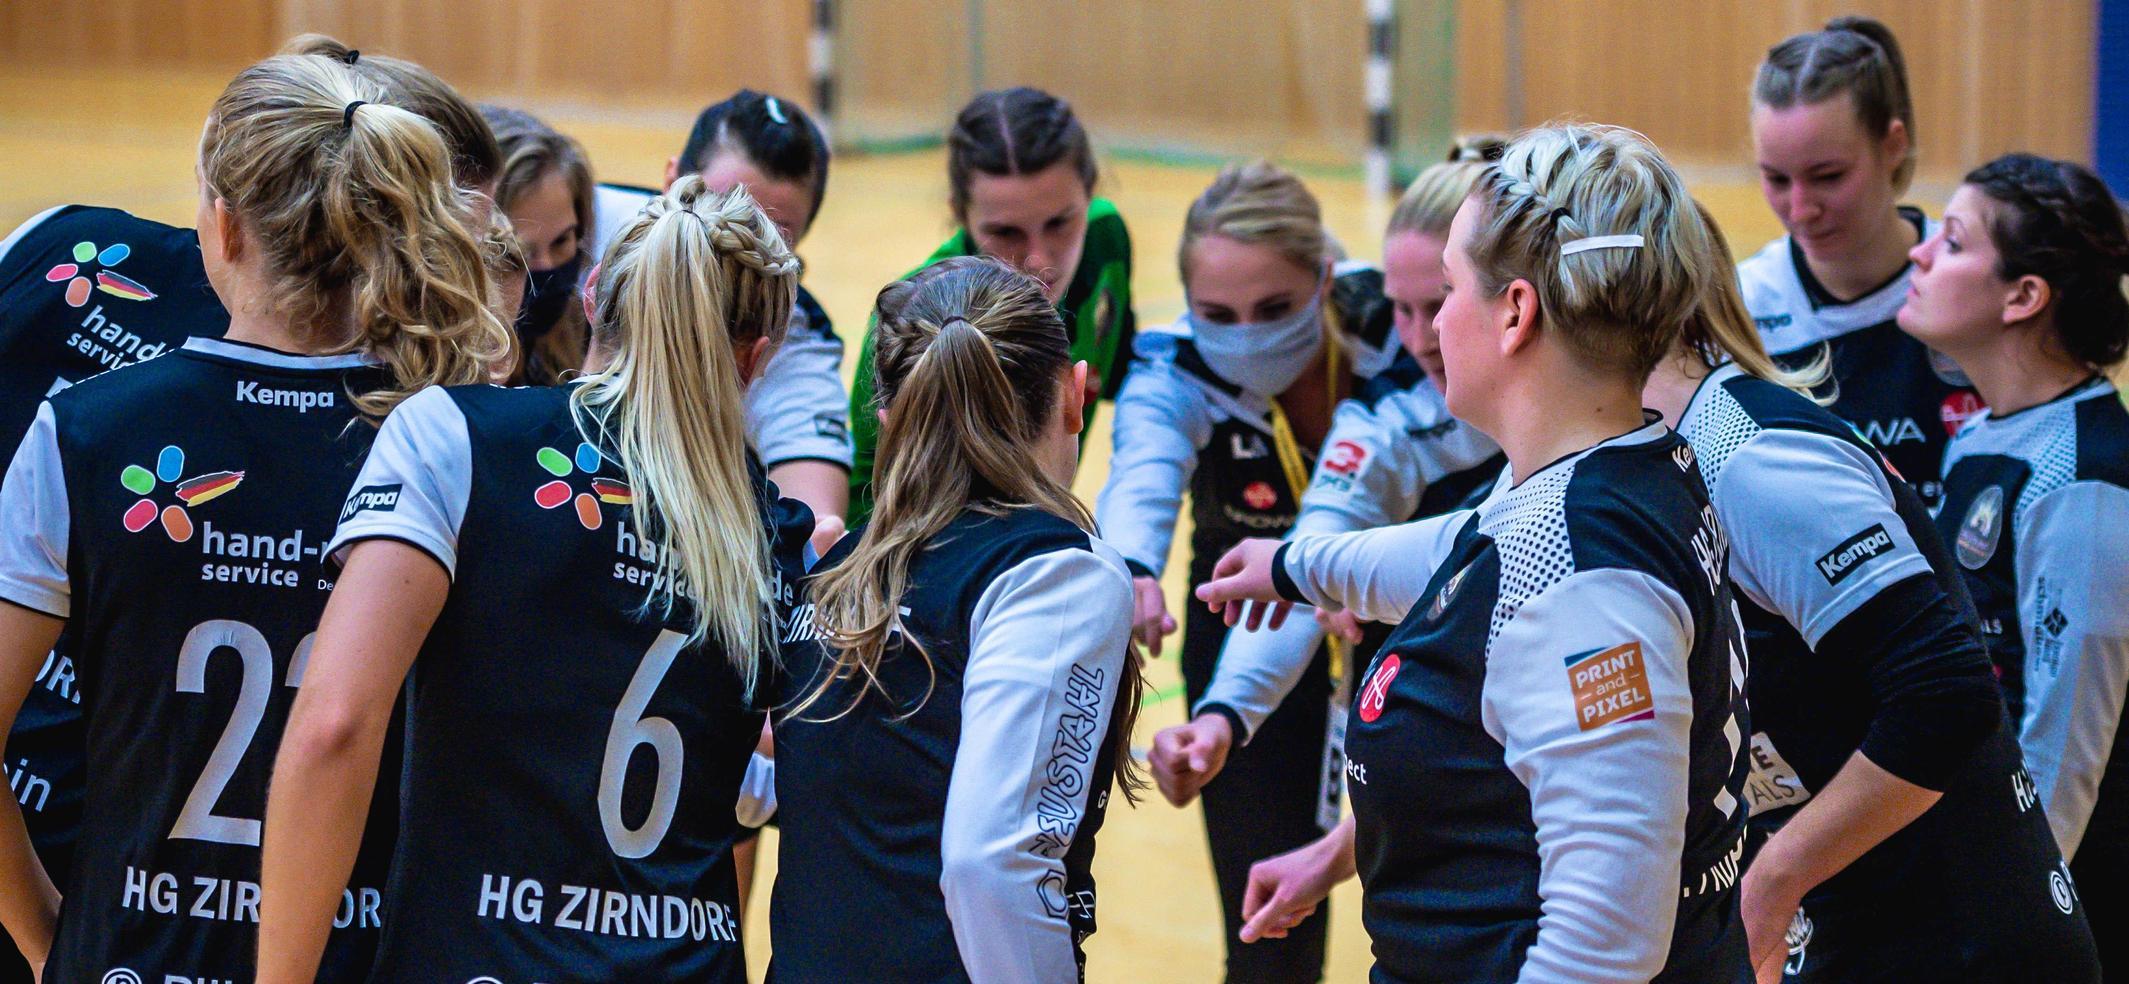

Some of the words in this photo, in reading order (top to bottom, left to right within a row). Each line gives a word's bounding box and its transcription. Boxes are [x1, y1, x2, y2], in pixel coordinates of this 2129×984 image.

[81, 304, 166, 361] hand
[1754, 313, 1792, 333] mpa
[66, 333, 130, 371] servi
[236, 380, 334, 413] Kempa
[1672, 445, 1695, 473] Ke
[343, 492, 398, 519] Kmpa
[202, 521, 328, 562] hand-
[1820, 531, 1890, 579] Kempa
[201, 562, 299, 588] service
[317, 579, 334, 590] De
[1575, 650, 1635, 689] PRINT
[1596, 672, 1627, 696] and
[1583, 687, 1646, 723] PIXEL
[598, 628, 689, 859] 6
[1345, 754, 1367, 785] ect
[1749, 774, 1795, 805] ALS
[122, 866, 178, 914] HG
[477, 874, 544, 923] HG
[554, 884, 737, 942] ZIRNDORF
